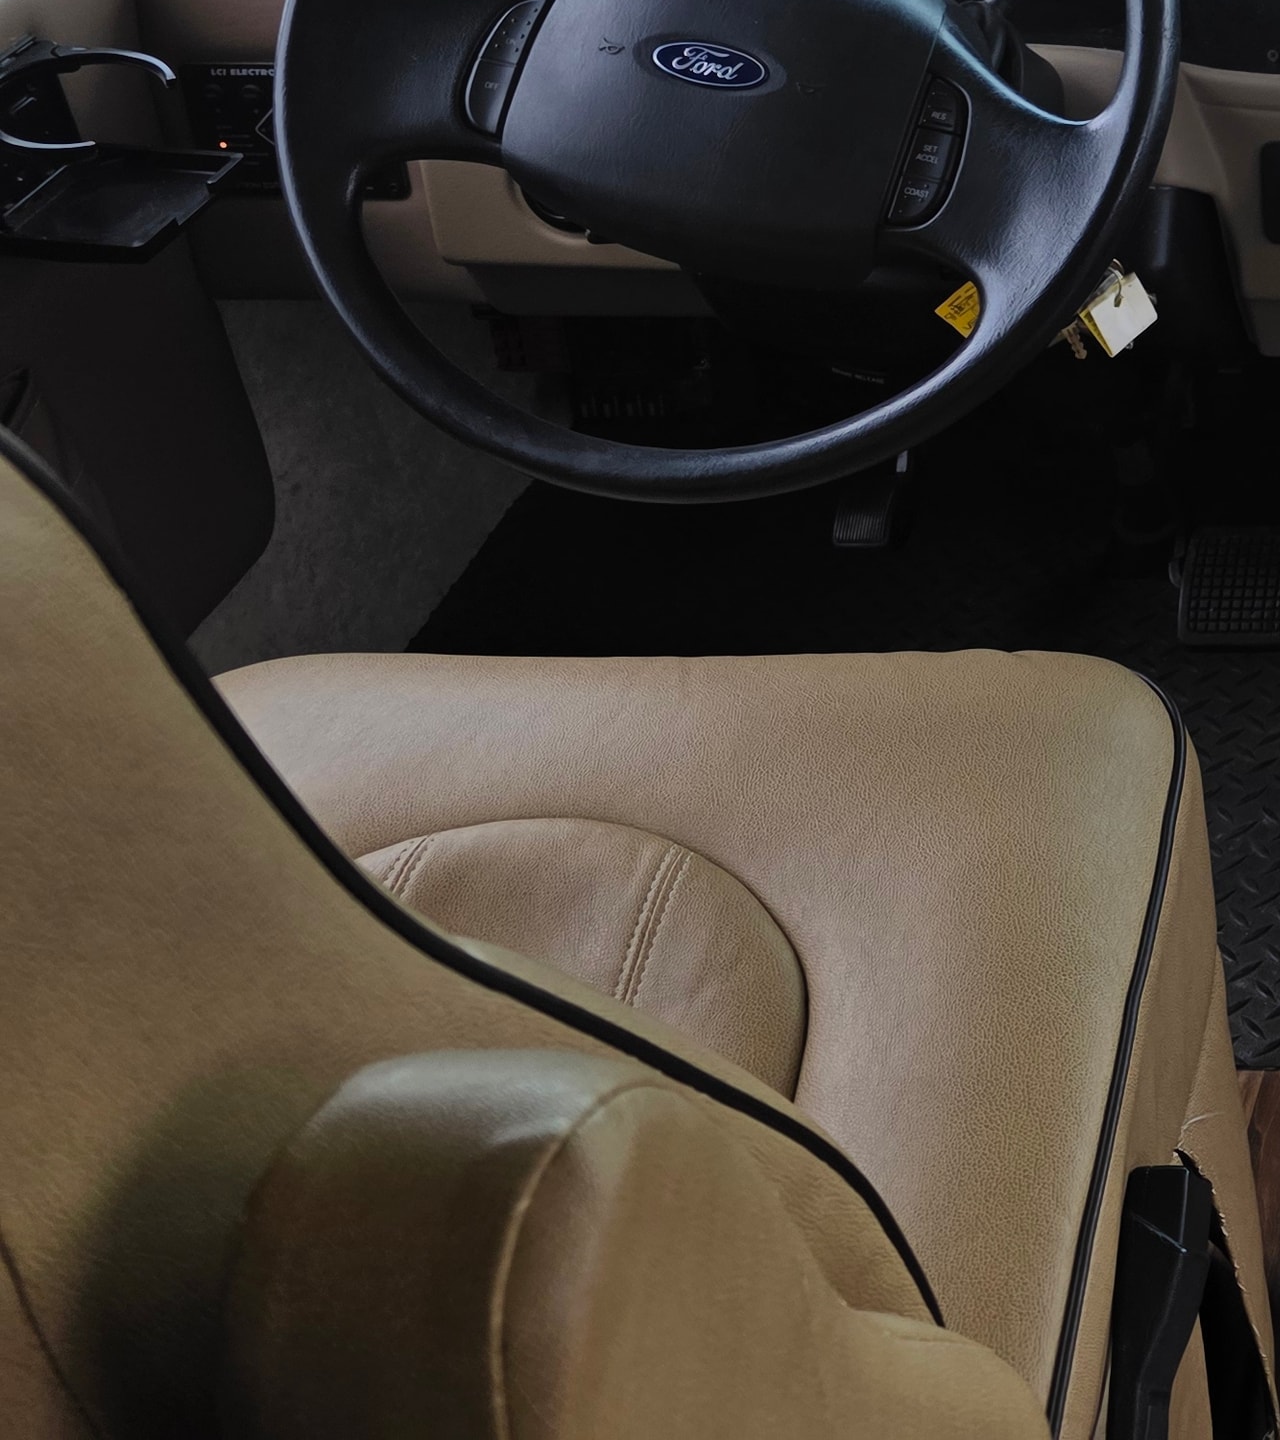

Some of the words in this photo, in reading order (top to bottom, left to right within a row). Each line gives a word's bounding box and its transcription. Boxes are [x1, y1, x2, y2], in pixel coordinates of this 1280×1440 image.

[671, 46, 745, 80] Ford
[923, 144, 939, 154] SET
[903, 186, 930, 199] COAST
